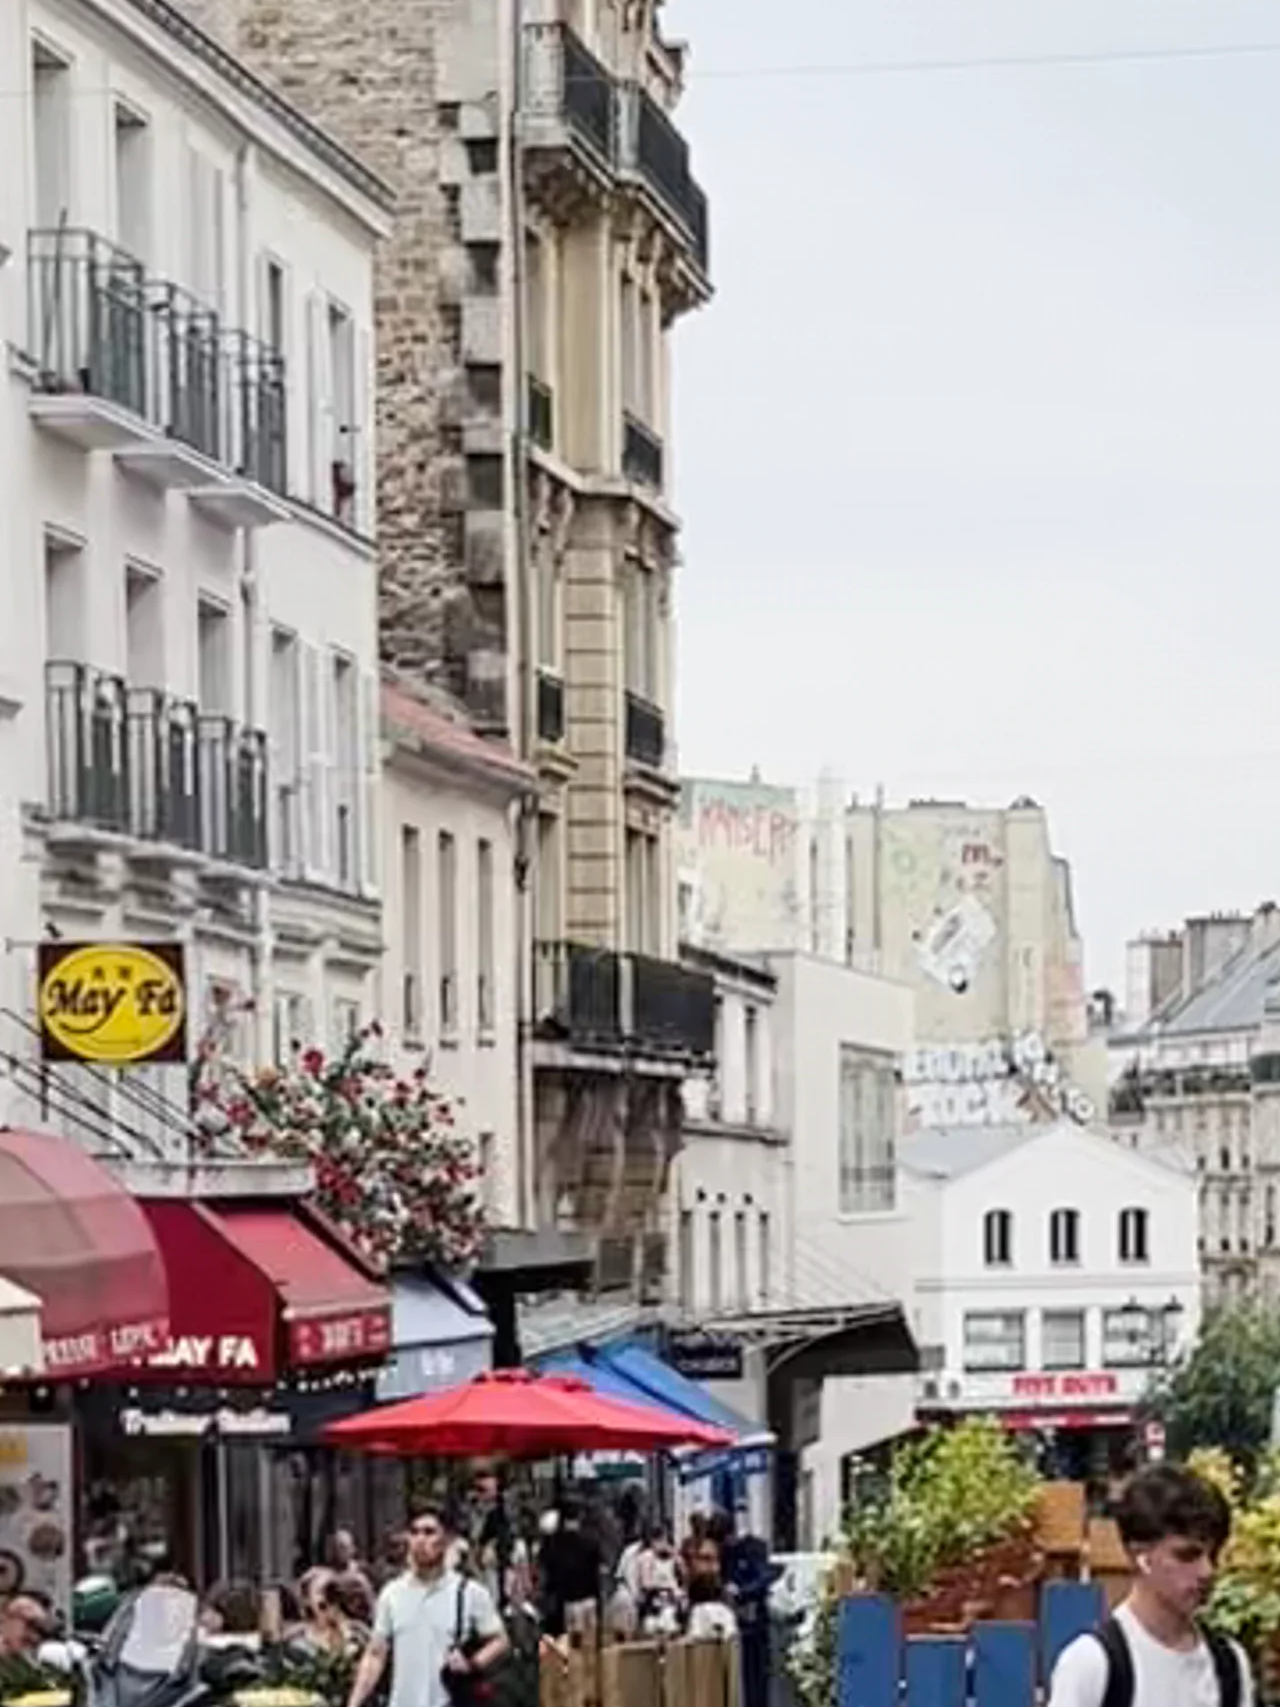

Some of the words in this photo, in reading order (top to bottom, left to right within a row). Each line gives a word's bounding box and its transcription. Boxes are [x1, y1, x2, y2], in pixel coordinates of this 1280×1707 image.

[46, 975, 128, 1034] May
[135, 978, 178, 1017] Fa
[220, 1336, 260, 1369] FA
